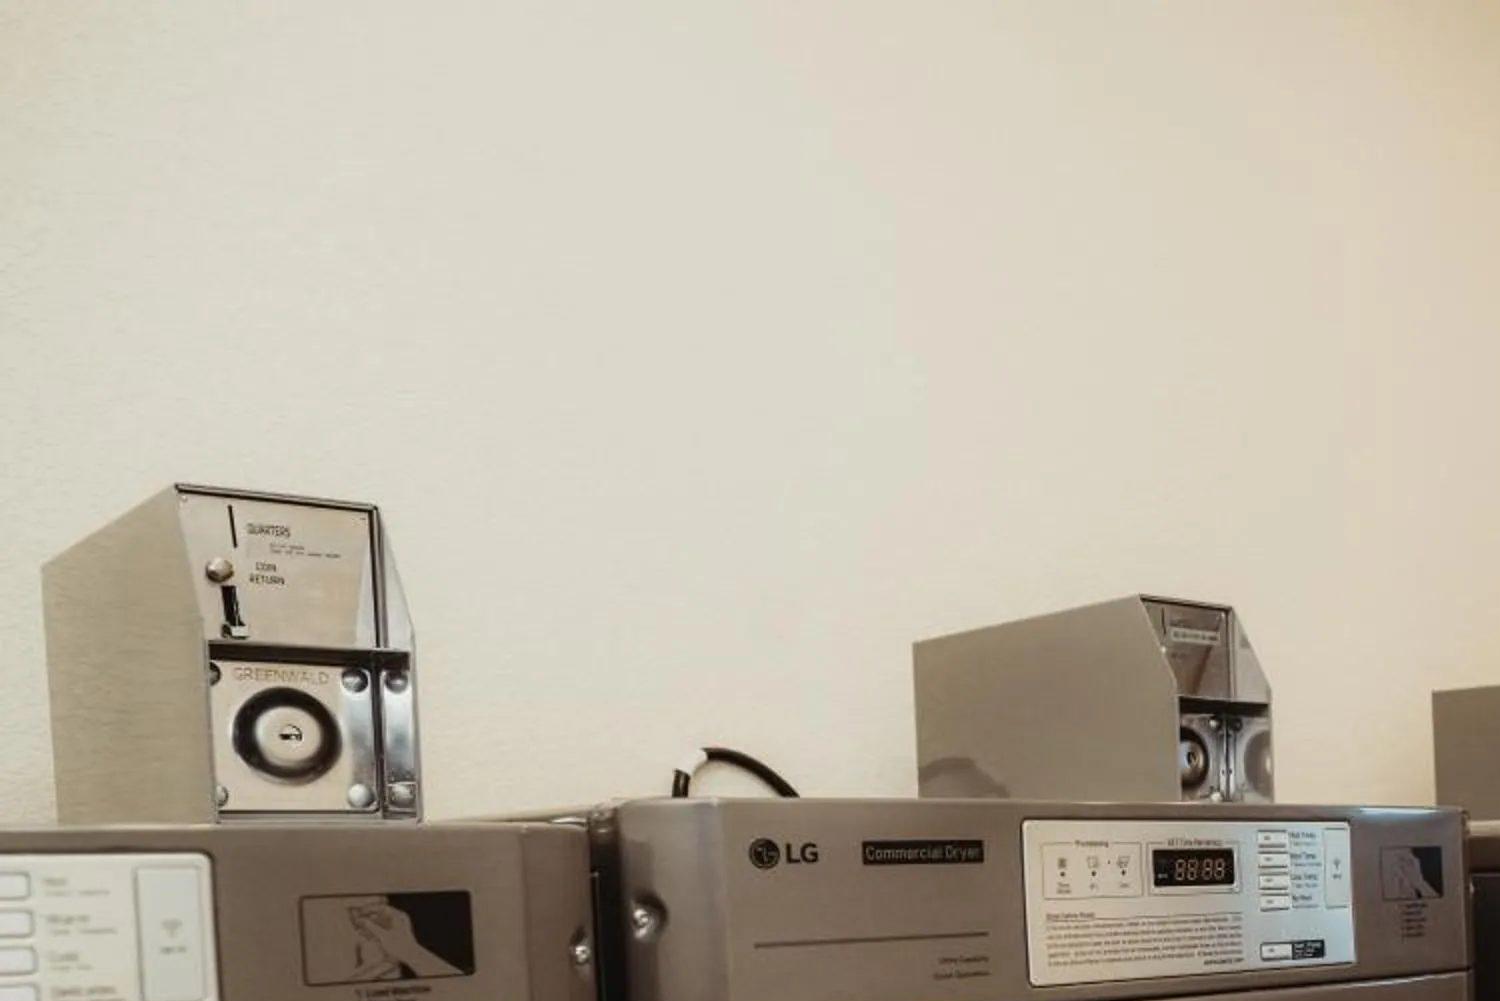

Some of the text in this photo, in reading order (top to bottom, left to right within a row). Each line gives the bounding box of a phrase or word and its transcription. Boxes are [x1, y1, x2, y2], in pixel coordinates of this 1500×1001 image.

[247, 522, 291, 538] QUARTERS
[233, 667, 330, 685] GREENWALD
[786, 843, 819, 864] LG
[865, 845, 943, 861] Commercial
